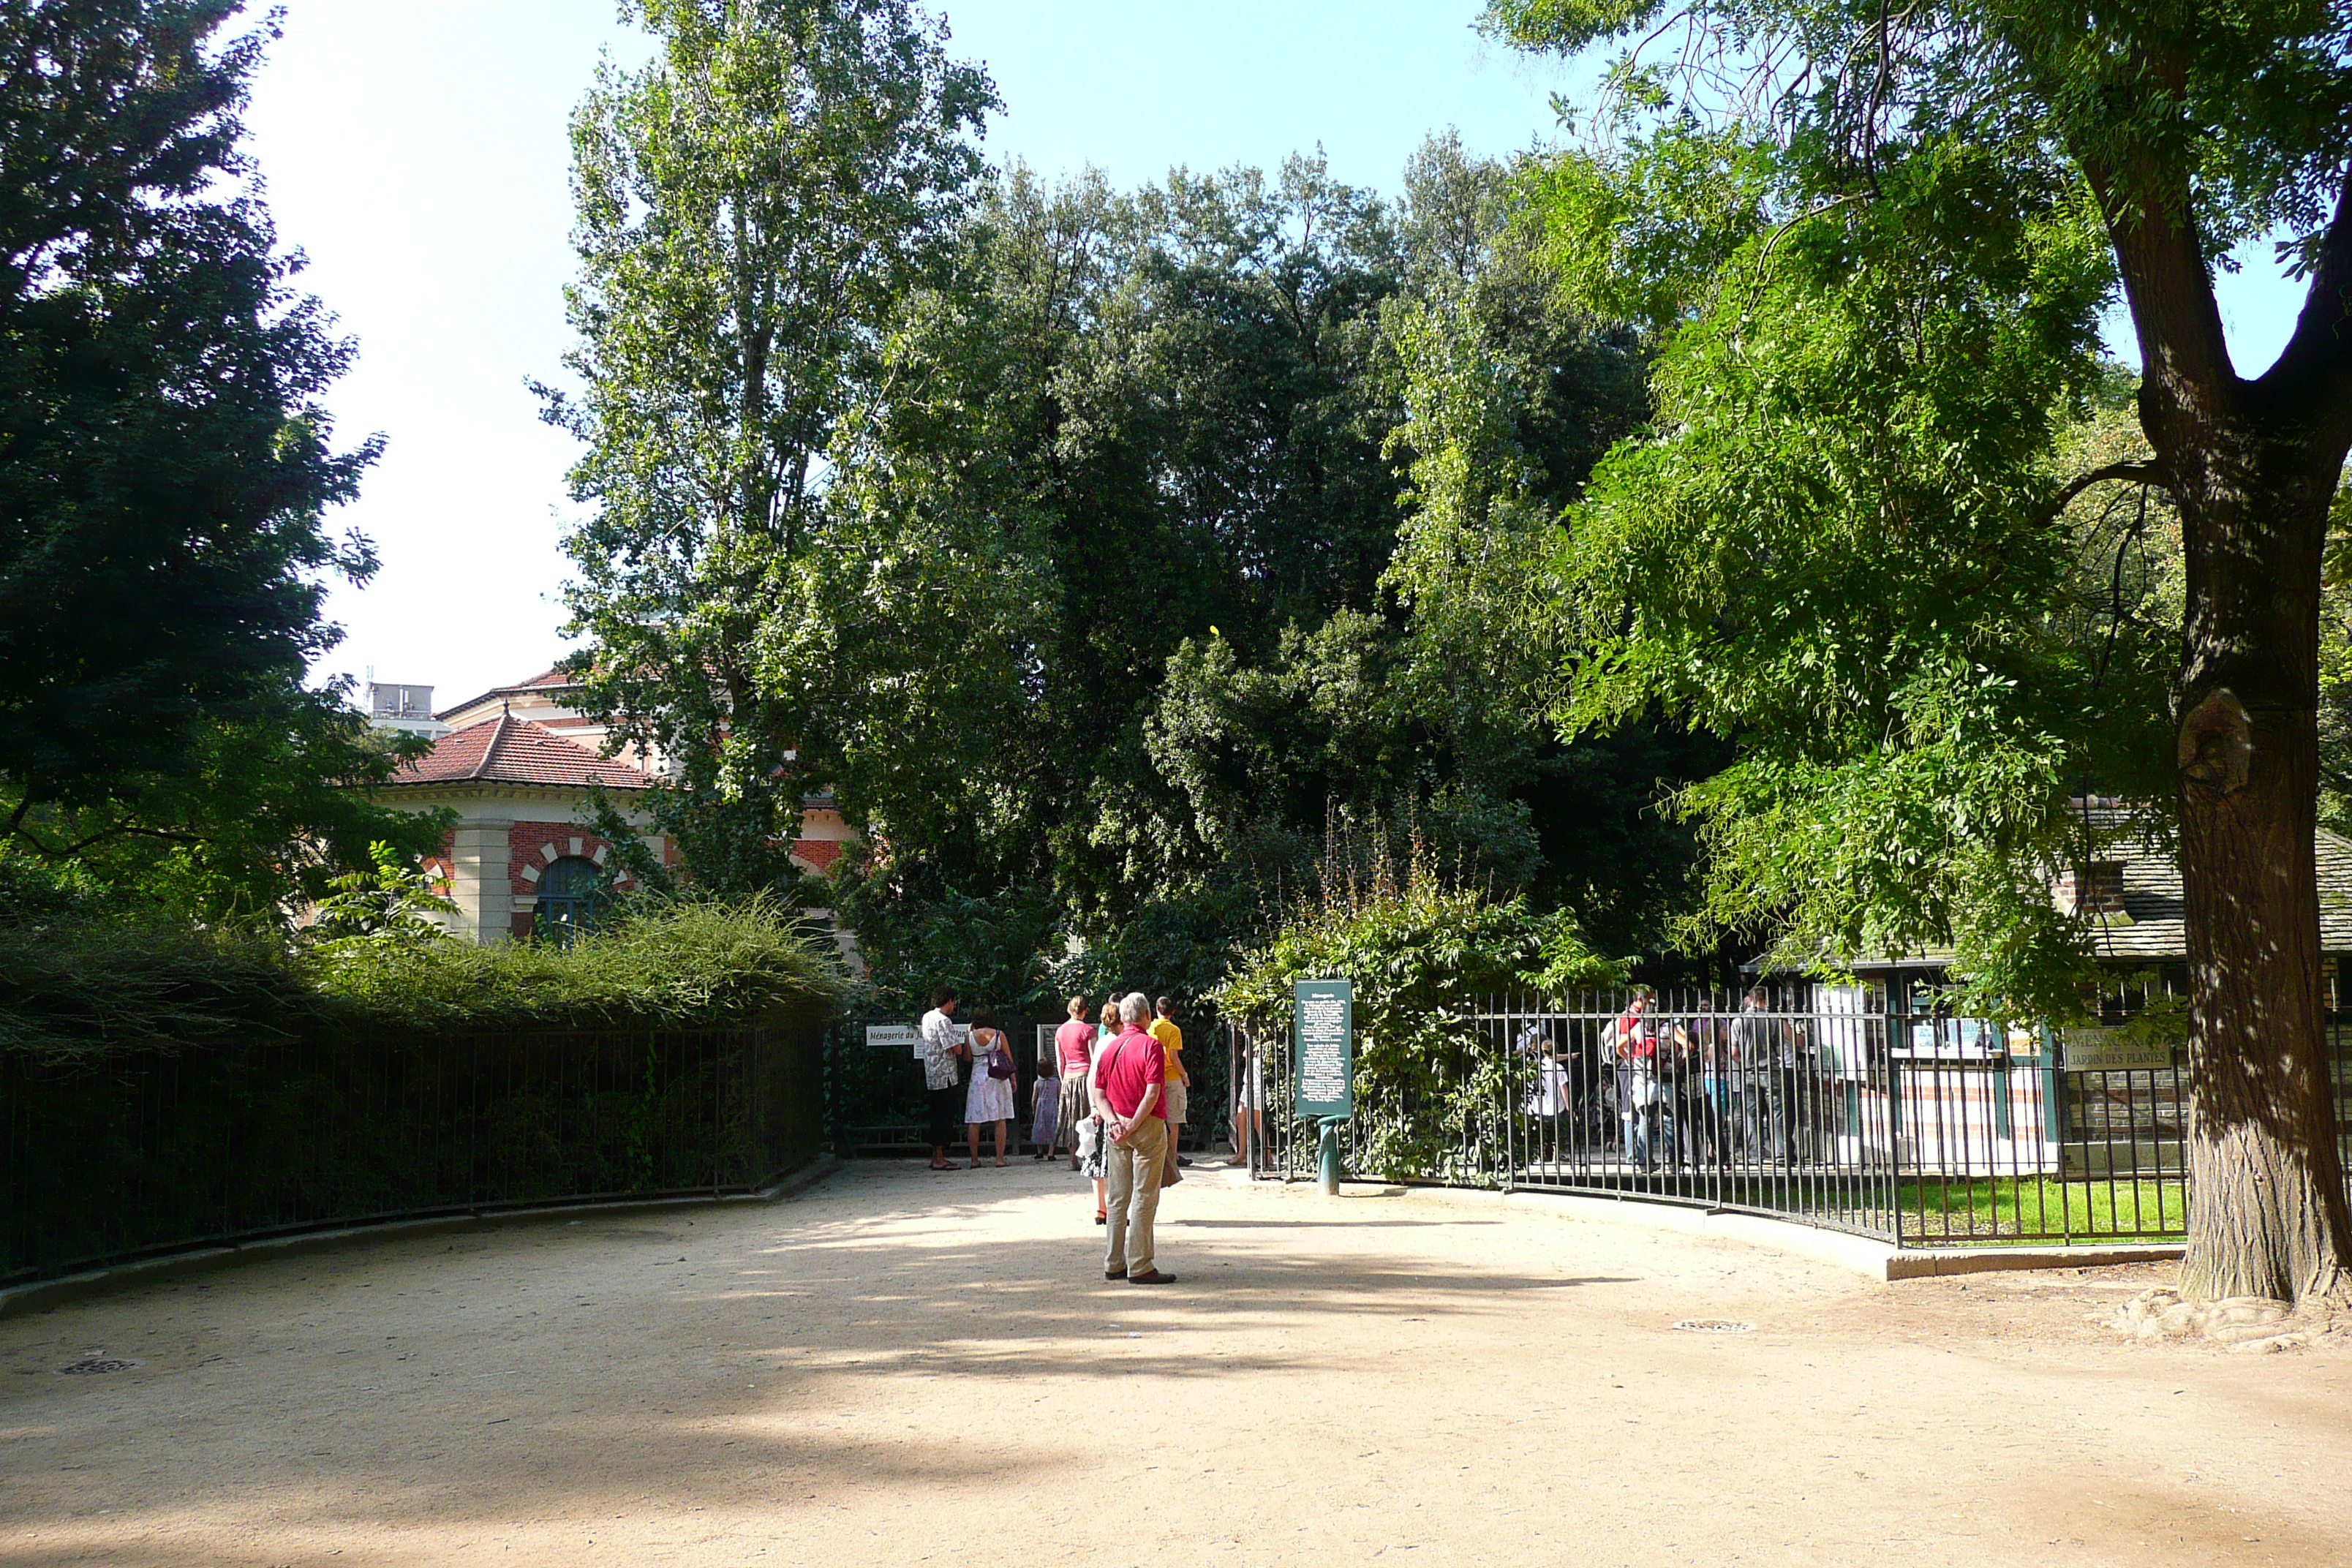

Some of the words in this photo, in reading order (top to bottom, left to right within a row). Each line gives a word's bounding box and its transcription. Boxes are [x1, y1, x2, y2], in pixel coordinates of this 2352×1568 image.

[870, 1031, 904, 1041] Ménagerie
[905, 1031, 914, 1039] du
[2071, 1055, 2102, 1065] JARDIN
[2106, 1053, 2124, 1064] DES
[2127, 1052, 2166, 1063] PLANTES
